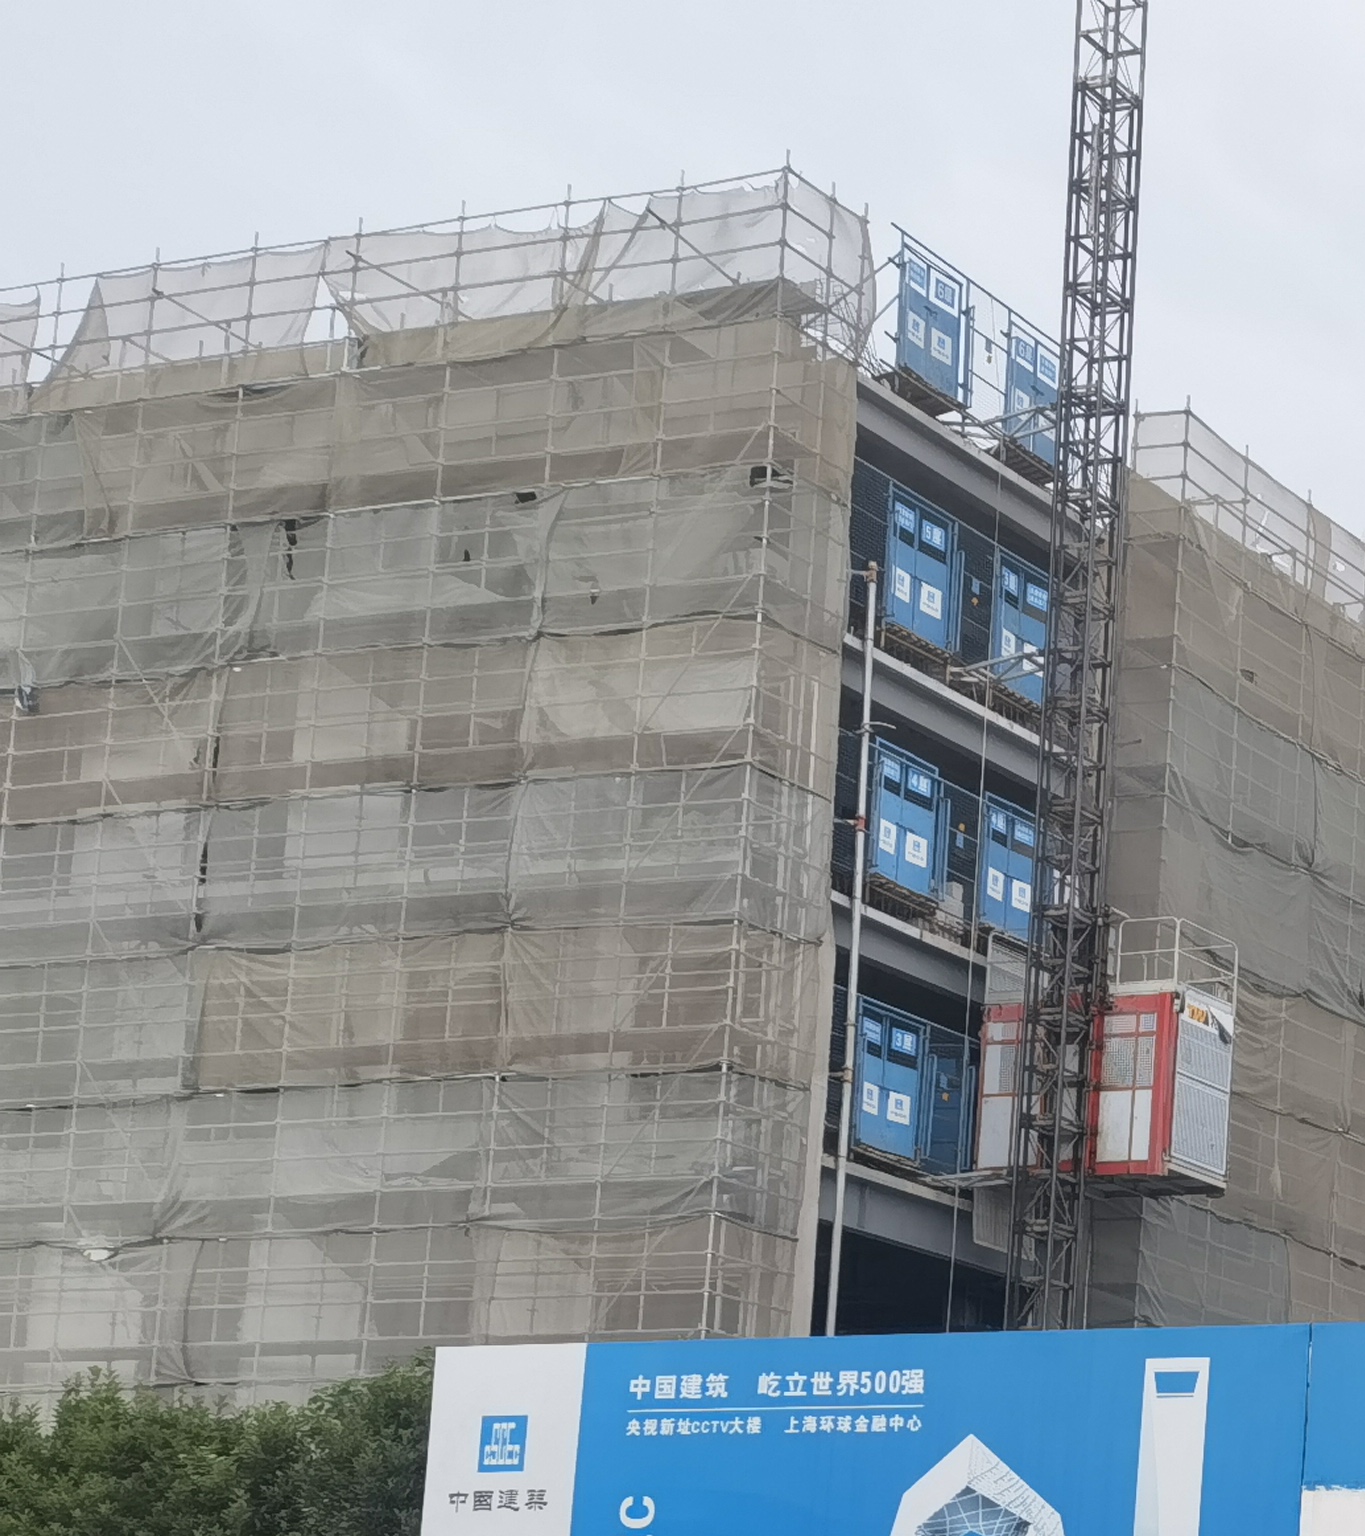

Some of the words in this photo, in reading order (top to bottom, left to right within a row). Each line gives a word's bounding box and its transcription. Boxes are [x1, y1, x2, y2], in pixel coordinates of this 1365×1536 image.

[629, 1374, 729, 1400] 中国建筑
[757, 1370, 925, 1396] 屹立世界500强
[626, 1416, 762, 1437] 央视新址CCTV大楼
[783, 1414, 923, 1434] 上海环球金融中心
